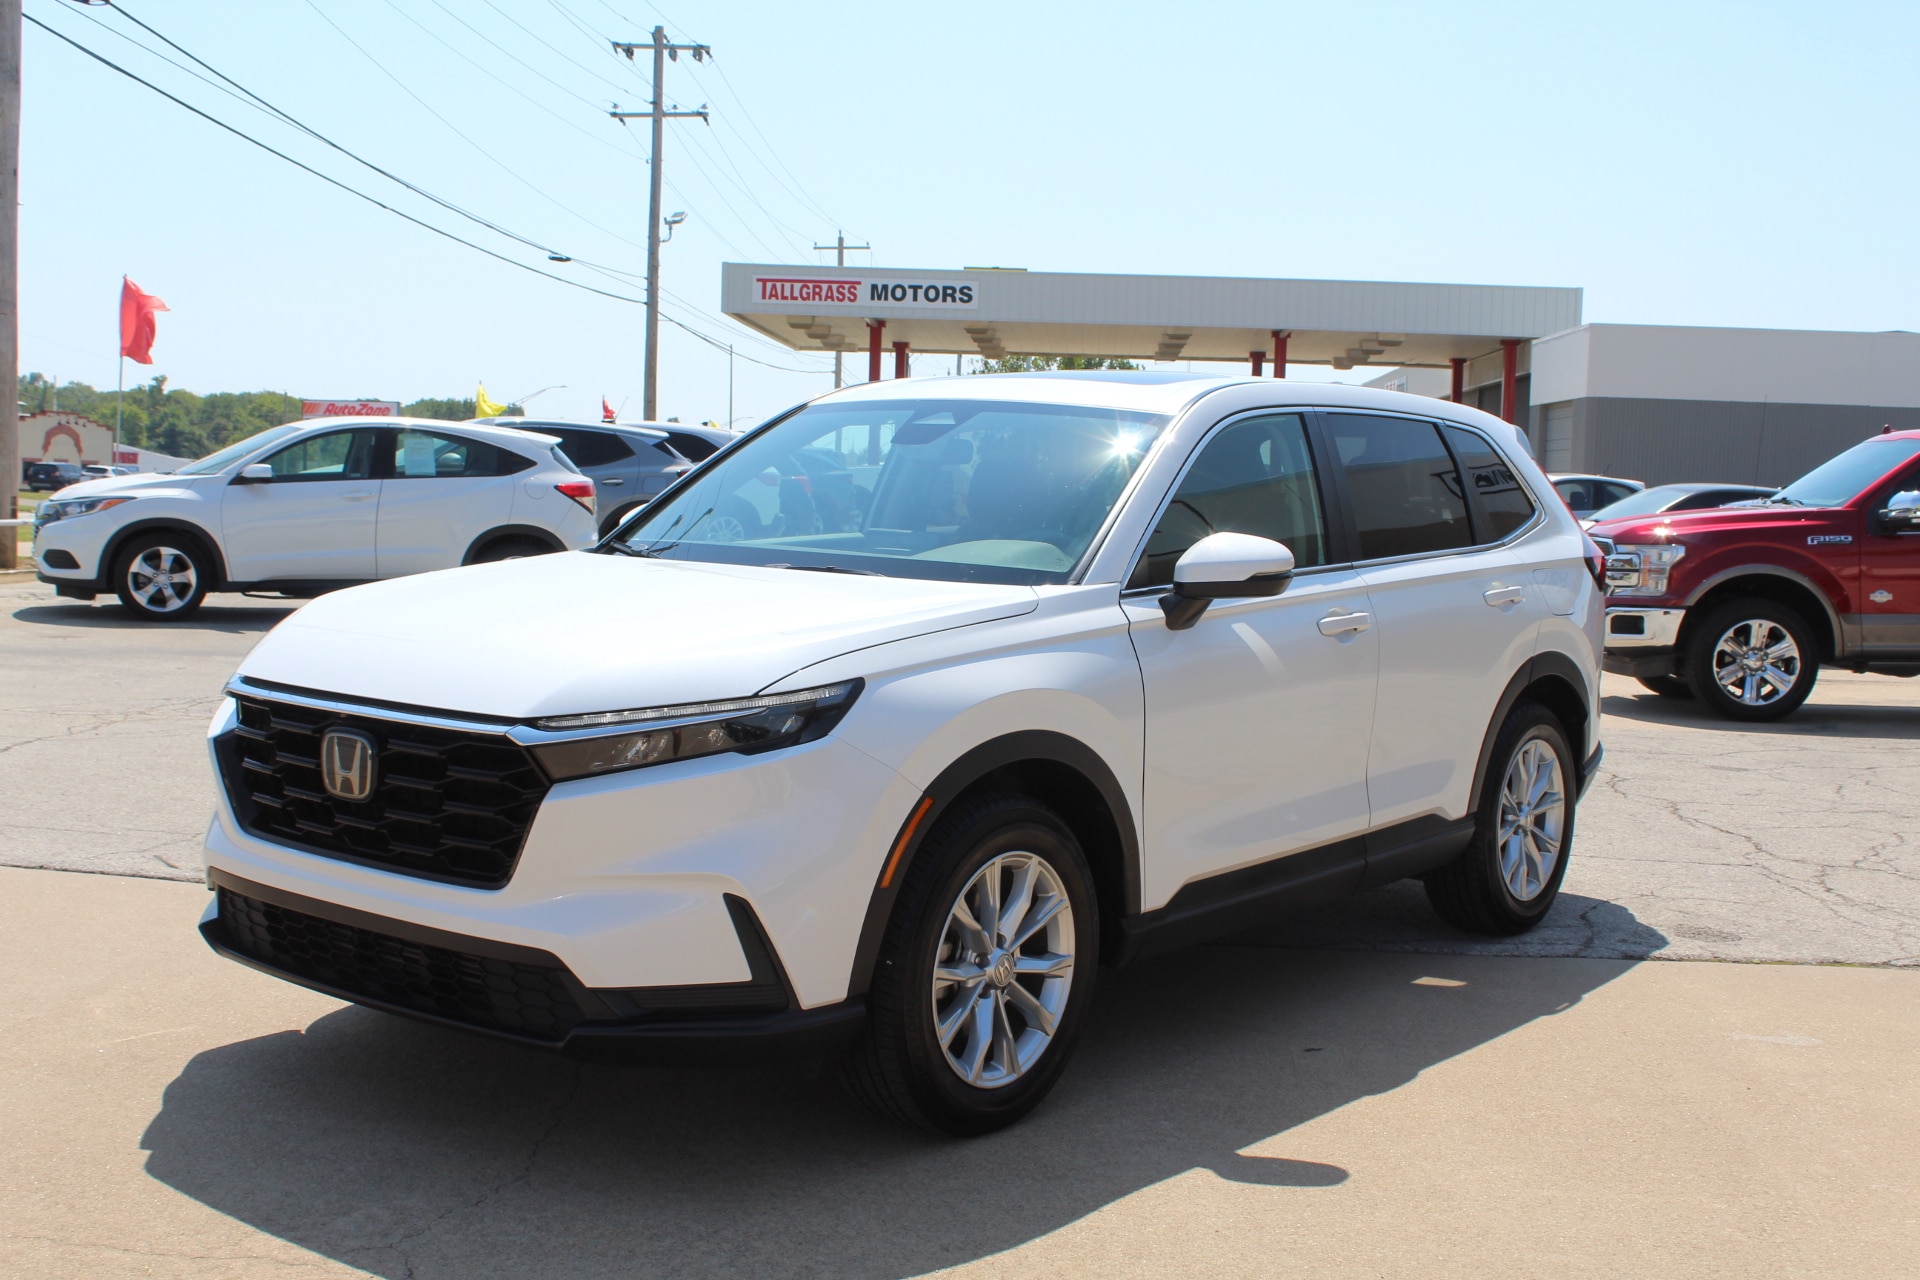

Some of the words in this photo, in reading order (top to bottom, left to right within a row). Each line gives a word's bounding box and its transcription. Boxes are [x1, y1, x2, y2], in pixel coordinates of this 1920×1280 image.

[756, 278, 862, 303] TALLGRASS
[870, 283, 974, 304] MOTORS
[323, 403, 391, 416] AutoZone
